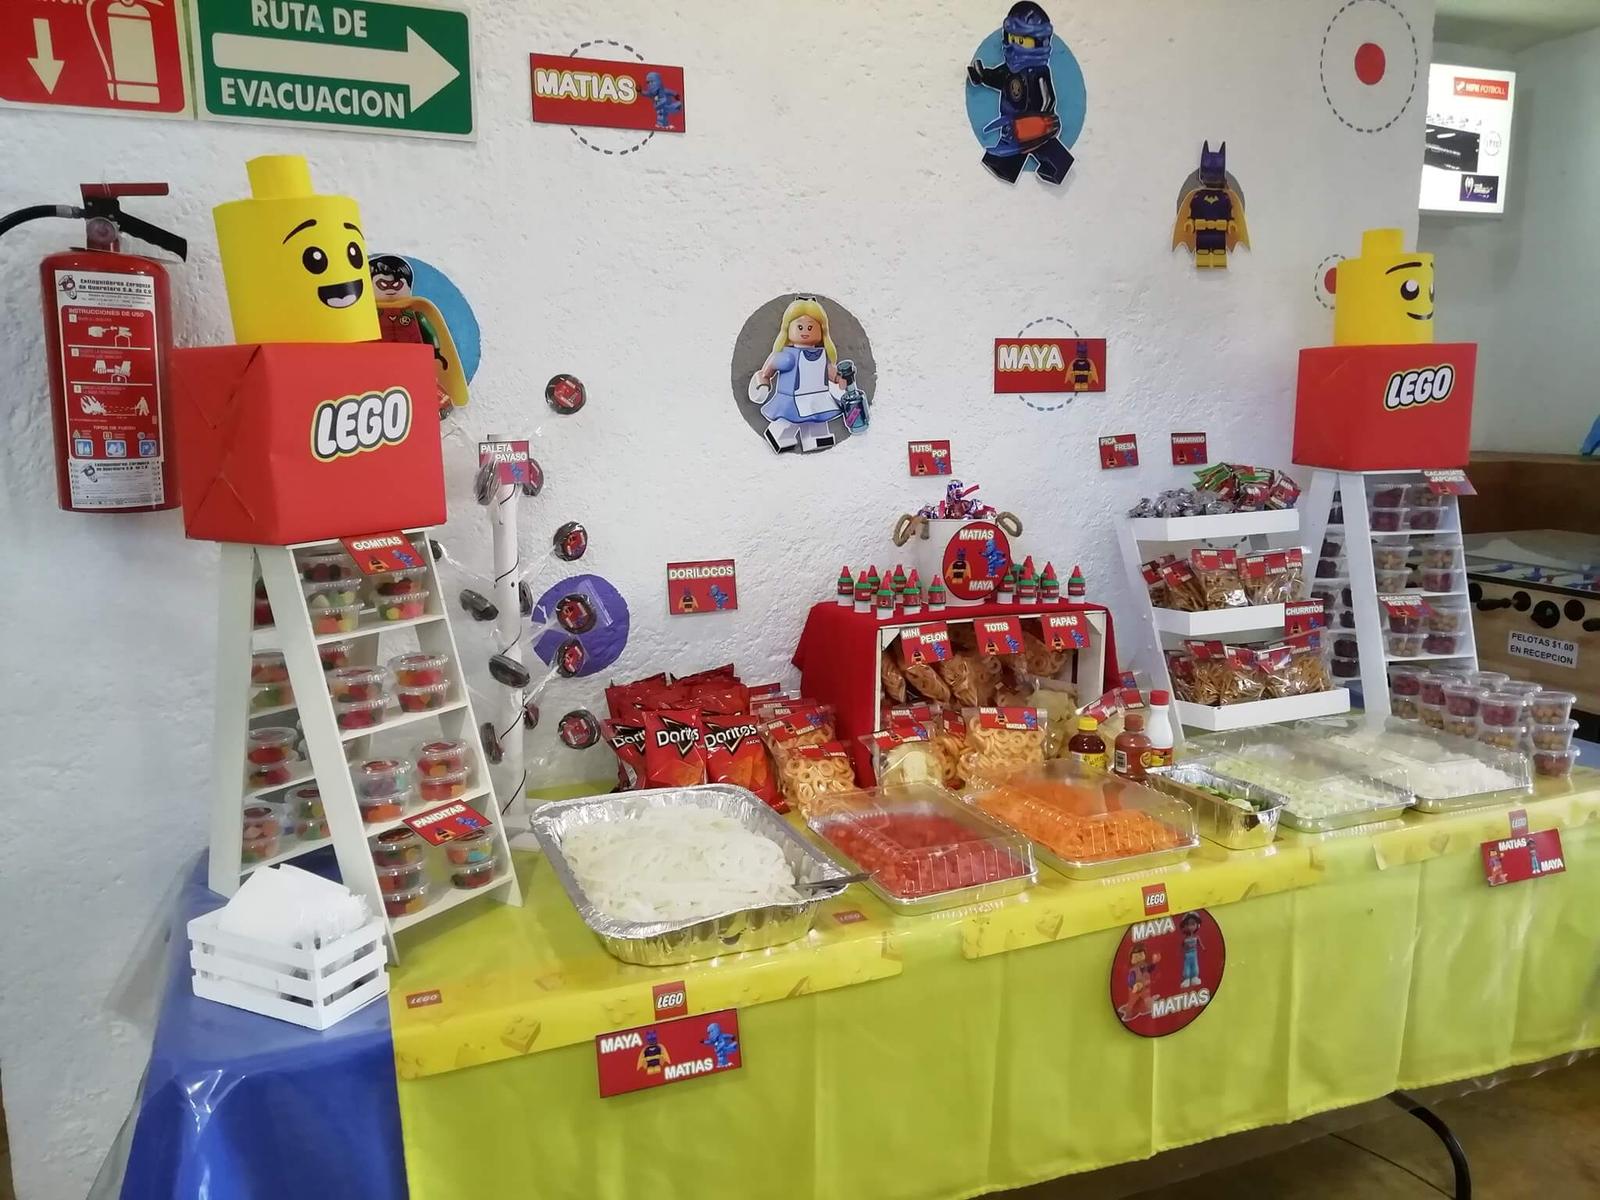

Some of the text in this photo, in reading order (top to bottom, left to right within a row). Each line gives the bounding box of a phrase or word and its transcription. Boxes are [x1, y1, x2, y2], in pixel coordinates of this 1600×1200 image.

[251, 0, 368, 38] RUTA DE
[535, 69, 636, 103] MATIAS
[220, 77, 406, 119] EVACUACION
[998, 344, 1065, 371] MAYA
[1384, 363, 1455, 410] LEGO
[311, 387, 412, 461] LEGO
[481, 443, 513, 453] PALETA
[910, 443, 932, 453] TUTSI
[1100, 437, 1117, 446] PICA
[1114, 442, 1136, 451] FRESA
[495, 452, 528, 462] PAYASO
[932, 449, 948, 458] POP
[959, 529, 995, 540] MATIAS
[353, 536, 403, 551] GOMITAS
[669, 566, 734, 580] DORILOCOS
[969, 580, 995, 591] MAYA
[1286, 605, 1324, 616] CHURRITOS
[983, 622, 1009, 632] TOTIS
[1050, 616, 1078, 627] PAPAS
[901, 628, 921, 638] MINI
[920, 631, 948, 645] PELON
[1511, 632, 1575, 652] PELOTAS $1.00
[1510, 645, 1574, 665] EN RECEPCION
[980, 707, 998, 715] MAYA
[703, 724, 757, 749] Doritos
[873, 731, 890, 739] MAYA
[411, 804, 467, 828] PANDITAS
[1498, 838, 1527, 851] MATIAS
[1540, 858, 1564, 872] MAYA
[1145, 892, 1166, 906] LEGO
[1132, 917, 1176, 942] MAYA
[410, 994, 438, 1005] LEGO
[657, 992, 684, 1009] LEGO
[1152, 987, 1211, 1019] MATIAS
[600, 1033, 643, 1054] MAYA
[664, 1057, 714, 1080] MATIAS
